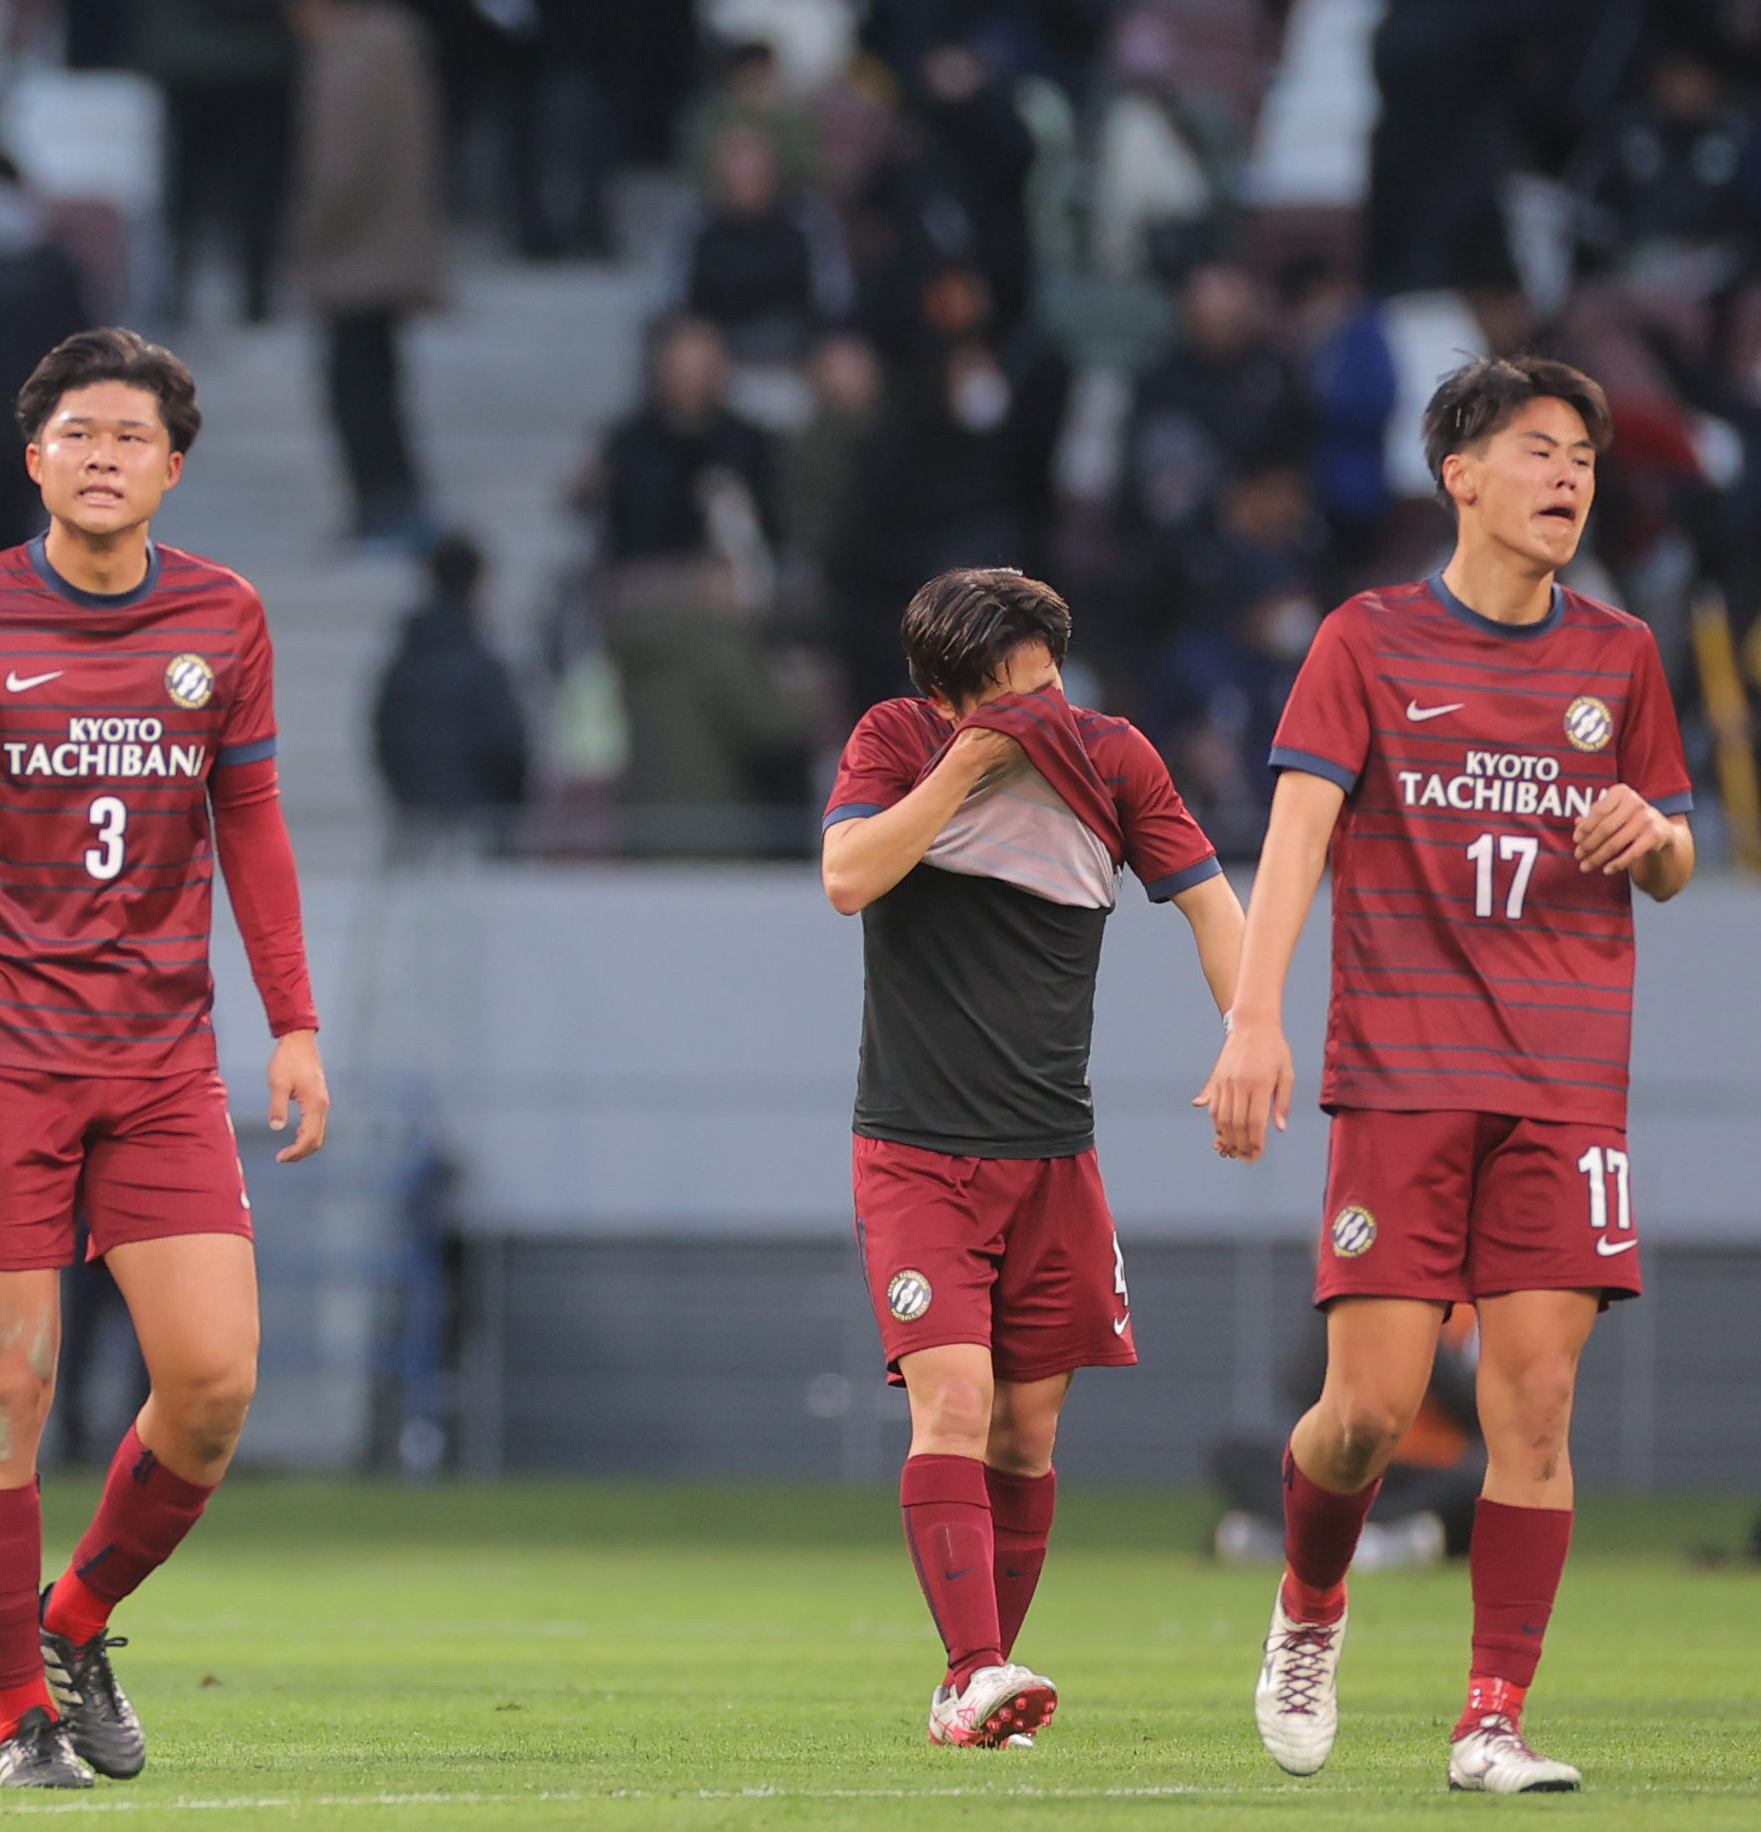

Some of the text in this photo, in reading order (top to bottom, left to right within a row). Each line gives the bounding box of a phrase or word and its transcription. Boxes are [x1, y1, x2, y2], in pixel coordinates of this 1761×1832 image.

[69, 717, 164, 743] KYOTO
[1398, 771, 1609, 819] TACHIBAN
[1465, 751, 1560, 782] KYOTO
[85, 796, 127, 880] 3
[1466, 833, 1539, 920] 17
[1577, 1146, 1631, 1230] 17
